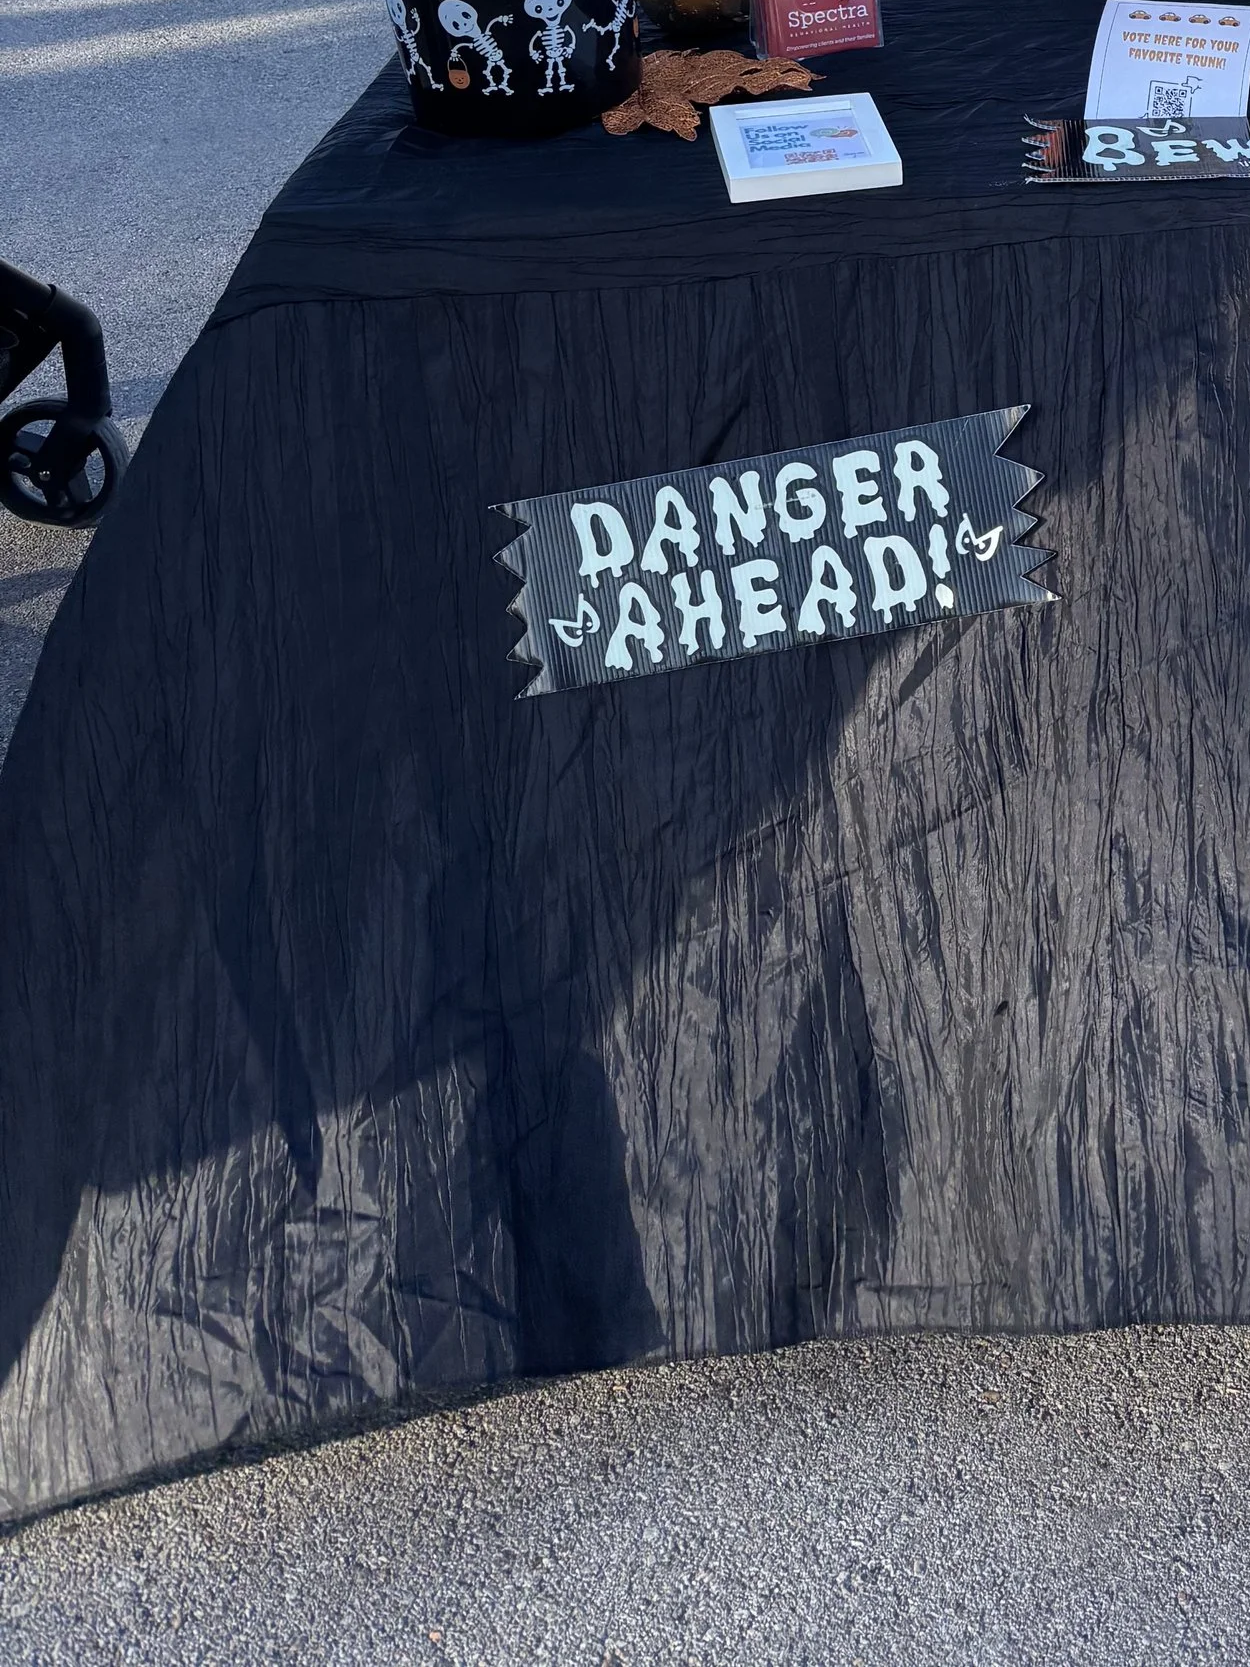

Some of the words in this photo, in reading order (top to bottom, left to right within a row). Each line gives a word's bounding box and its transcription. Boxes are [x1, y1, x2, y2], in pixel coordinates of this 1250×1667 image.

[788, 4, 869, 29] Spectra
[1122, 31, 1151, 44] VOTE
[1154, 34, 1183, 47] HERE
[1185, 37, 1207, 50] FOR
[1210, 39, 1240, 53] YOUR
[1128, 47, 1183, 65] FAVORITE
[1186, 53, 1227, 70] TRUNK!
[744, 124, 809, 134] Follow
[748, 134, 806, 146] Social
[749, 142, 812, 153] Media
[570, 439, 950, 588] DANGER
[604, 523, 955, 671] AHEAD!
